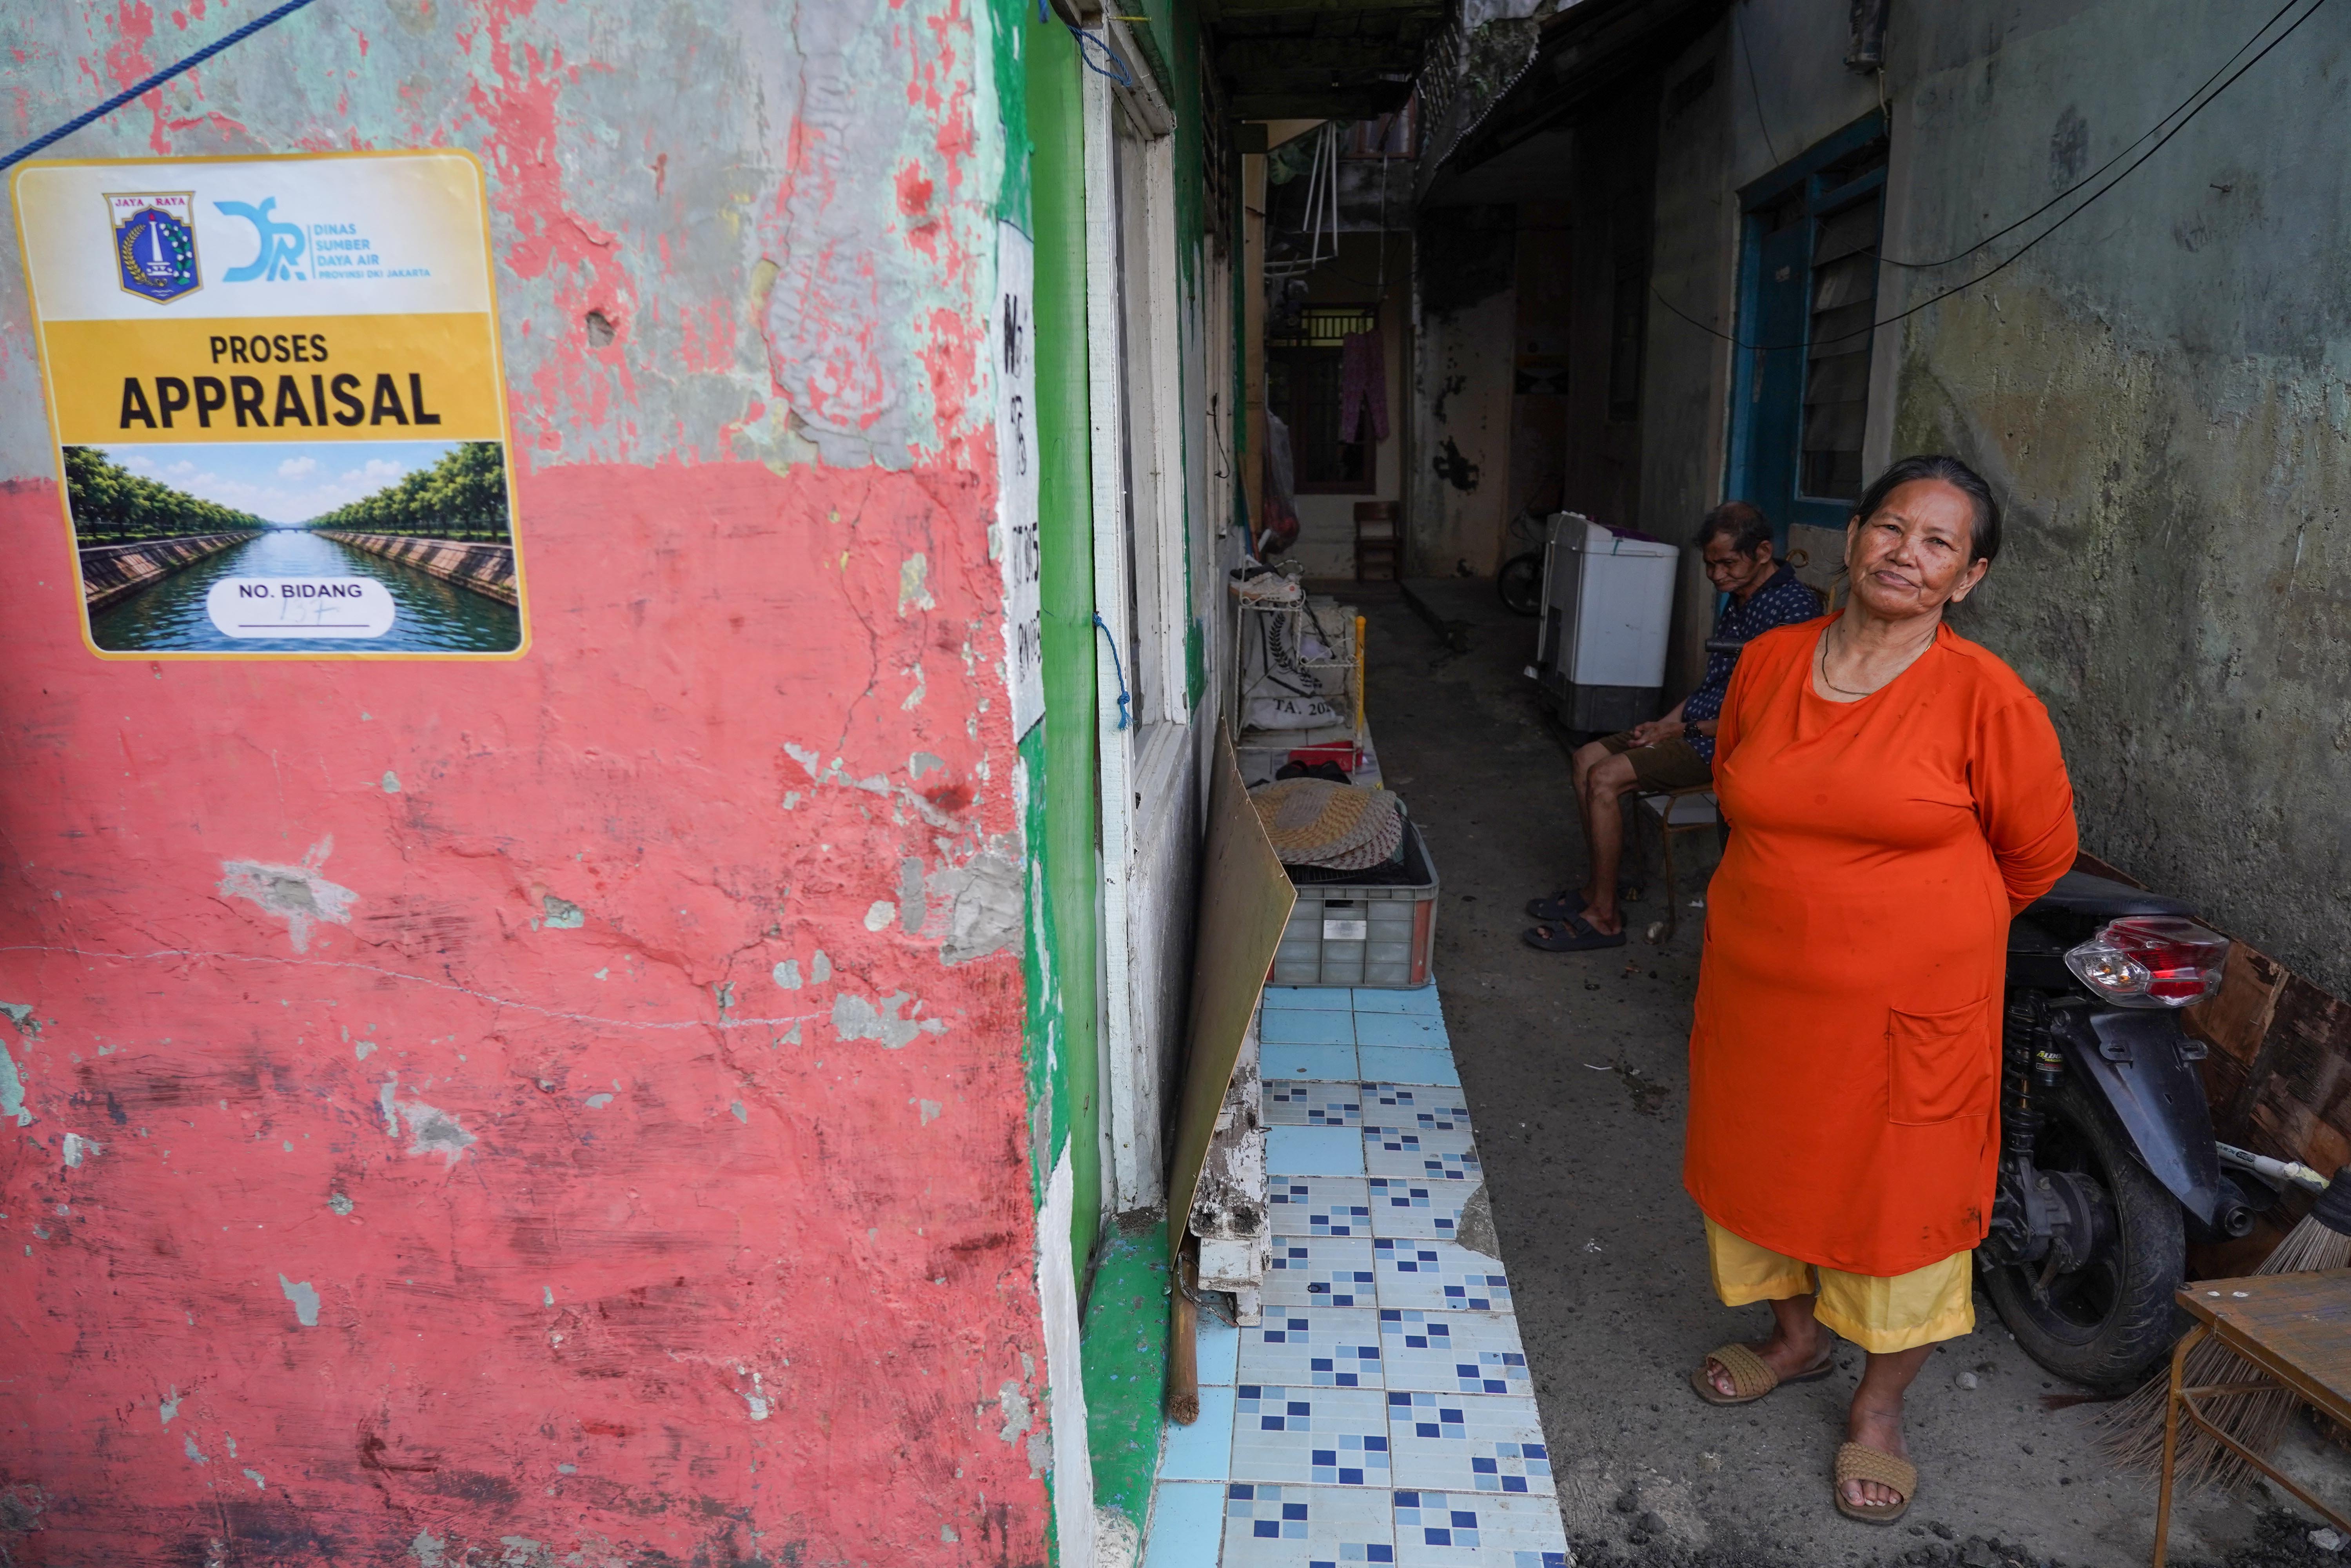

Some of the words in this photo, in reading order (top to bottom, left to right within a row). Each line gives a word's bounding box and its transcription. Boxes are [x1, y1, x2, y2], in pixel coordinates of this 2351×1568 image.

[115, 198, 143, 206] JAYA
[156, 197, 186, 205] RAYA
[314, 223, 356, 235] DINAS
[316, 239, 370, 251] SUMBER
[317, 255, 352, 266] DAYA
[358, 254, 379, 265] AIR
[318, 270, 364, 279] PROVINSI
[367, 270, 383, 278] DKI
[387, 269, 431, 278] JAKARTA
[210, 334, 328, 363] PROSES
[120, 373, 441, 429] APPRAISAL
[239, 584, 274, 598] NO.
[281, 584, 362, 598] BIDANG
[1273, 699, 1302, 714] TA.
